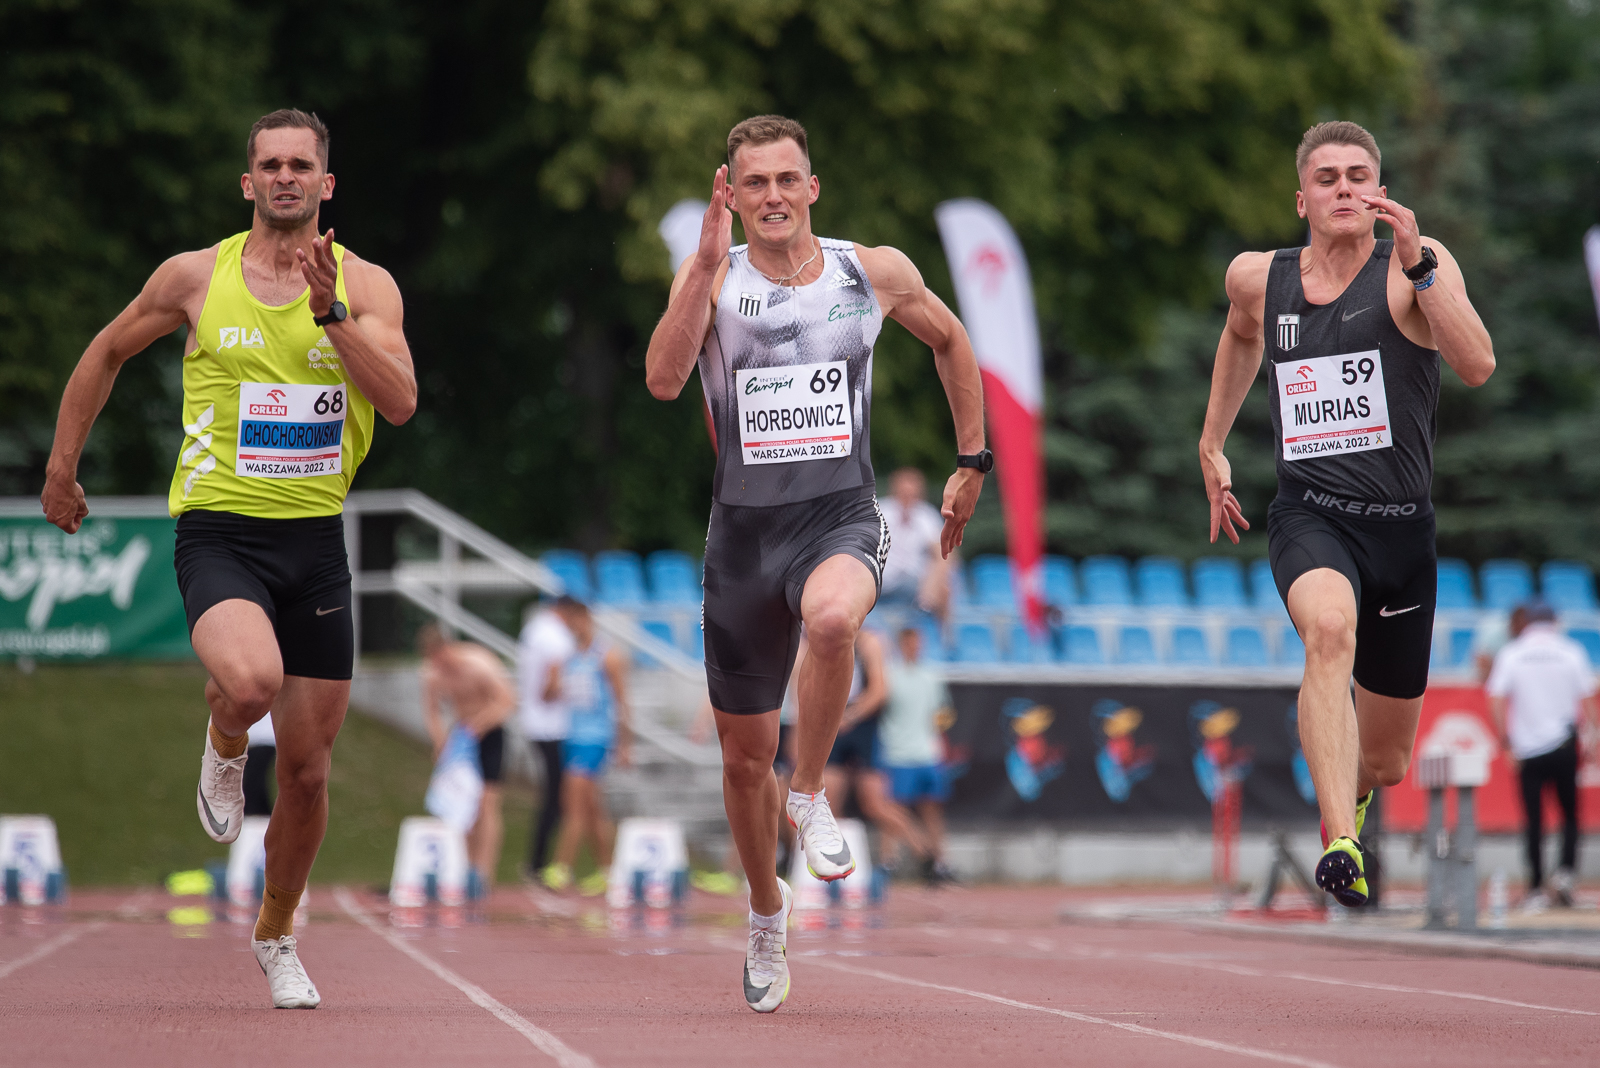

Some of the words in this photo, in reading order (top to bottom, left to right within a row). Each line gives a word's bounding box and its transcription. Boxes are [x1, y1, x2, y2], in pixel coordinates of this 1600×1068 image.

[827, 279, 857, 290] adidas
[828, 304, 872, 322] Europol
[1342, 357, 1375, 385] 59
[745, 376, 793, 395] Europol
[809, 368, 842, 394] 69
[1287, 382, 1315, 394] ORLEN
[251, 405, 285, 415] ORLEN
[313, 390, 343, 415] 68
[1294, 395, 1371, 427] MURIAS
[745, 403, 846, 433] HORBOWICZ
[244, 423, 340, 447] CHOCHOROWSKI
[751, 447, 808, 459] WARSZAWA
[810, 444, 834, 455] 2022
[1290, 440, 1343, 455] WARSZAWA
[1345, 436, 1370, 448] 2022
[245, 462, 301, 474] WARSZAWA
[304, 462, 324, 473] 2022
[1303, 489, 1365, 514] NIKE
[1365, 503, 1417, 517] PRO
